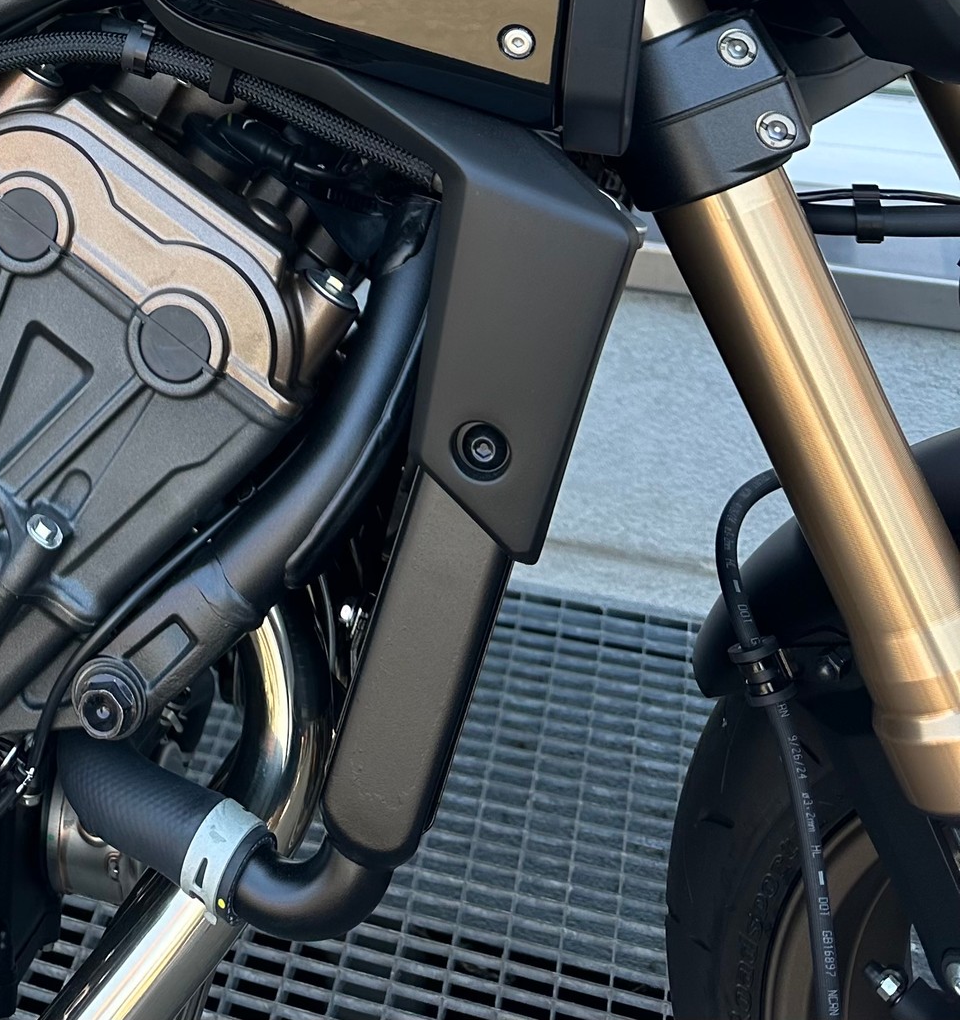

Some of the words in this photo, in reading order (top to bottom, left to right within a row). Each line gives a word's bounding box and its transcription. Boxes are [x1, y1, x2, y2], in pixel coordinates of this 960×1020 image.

[738, 604, 753, 623] DOT
[787, 734, 808, 780] 9/26/24
[810, 844, 822, 859] HL
[818, 896, 831, 917] DOT
[822, 930, 837, 977] GB16897
